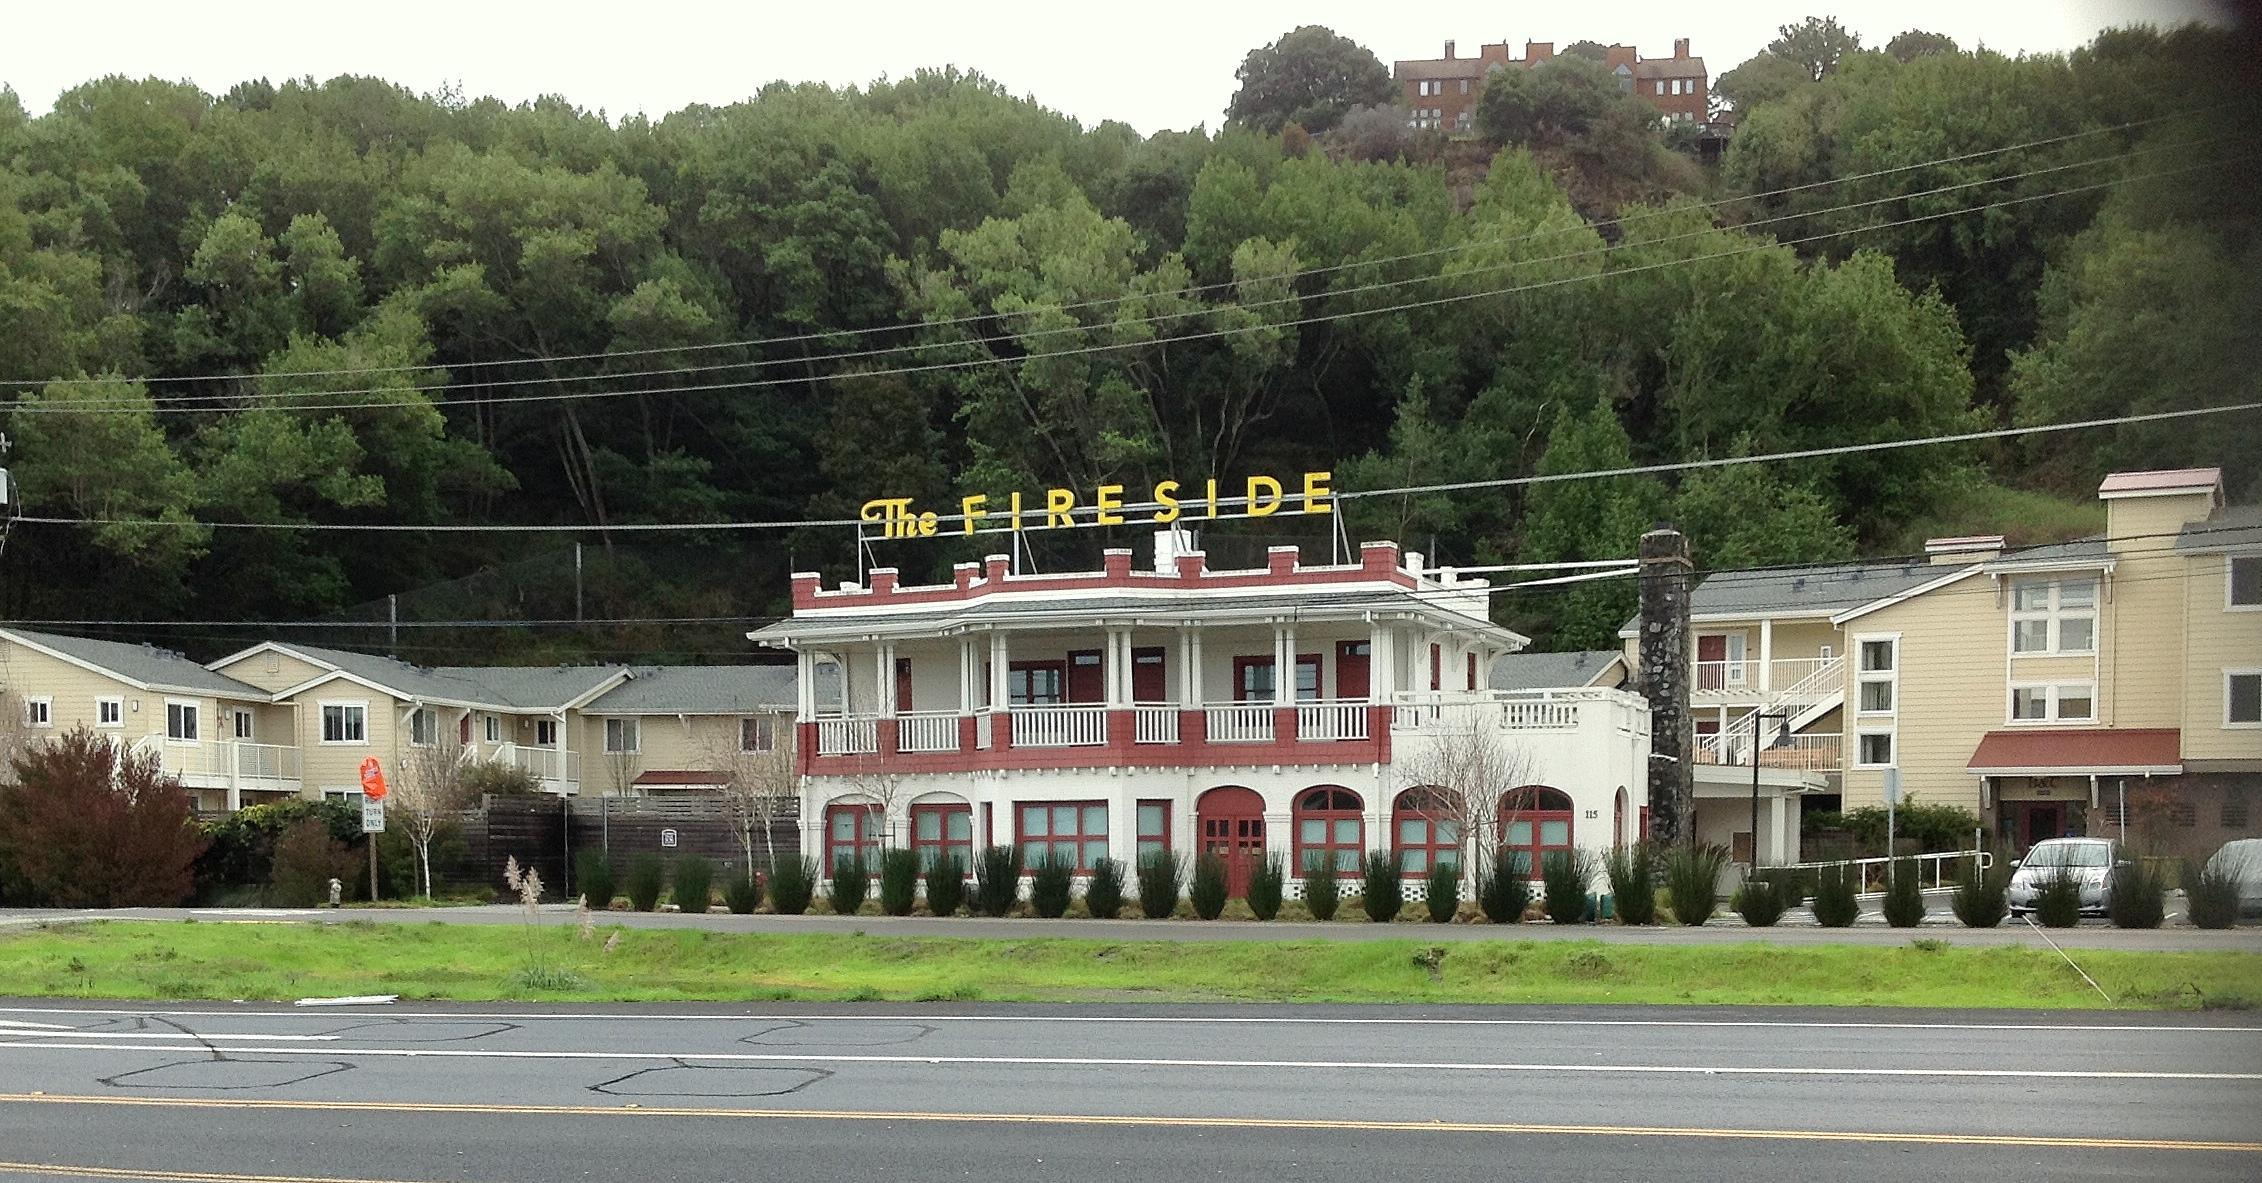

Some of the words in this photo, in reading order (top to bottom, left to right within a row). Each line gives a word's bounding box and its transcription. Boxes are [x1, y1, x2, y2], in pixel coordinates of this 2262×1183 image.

[861, 498, 938, 537] The
[962, 471, 1333, 536] FIRESIDE
[366, 808, 382, 816] TURN
[1585, 810, 1598, 819] 115
[366, 819, 381, 828] ONLY
